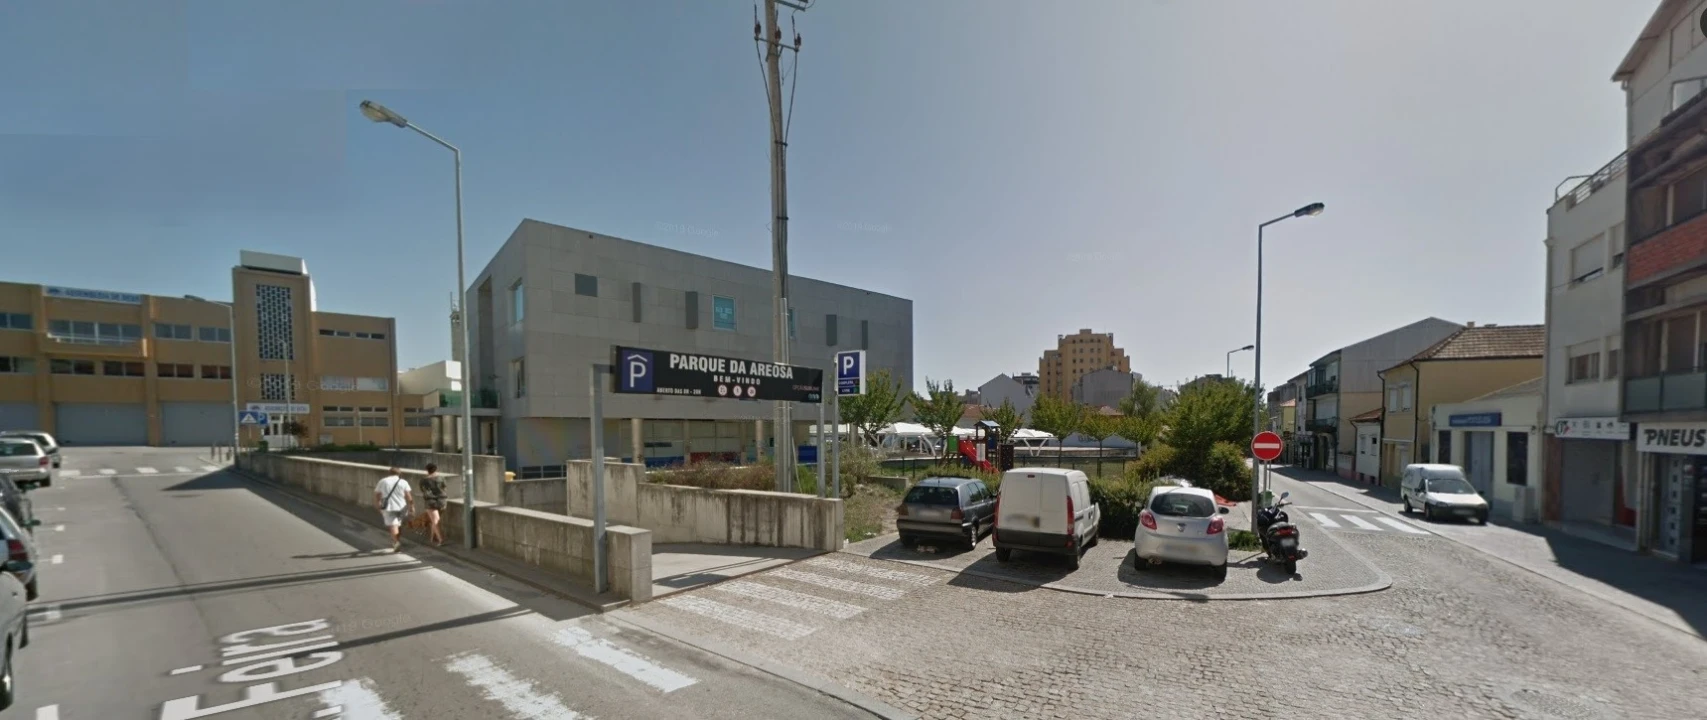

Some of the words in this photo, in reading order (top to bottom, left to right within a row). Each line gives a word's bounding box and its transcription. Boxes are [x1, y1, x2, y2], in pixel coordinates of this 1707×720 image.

[629, 361, 646, 388] P
[669, 353, 725, 373] PARQUE
[729, 360, 746, 375] DA
[749, 362, 793, 379] AREOSA
[843, 356, 854, 375] P
[713, 374, 761, 385] BEM-VINDO
[1644, 429, 1707, 447] PNEUS
